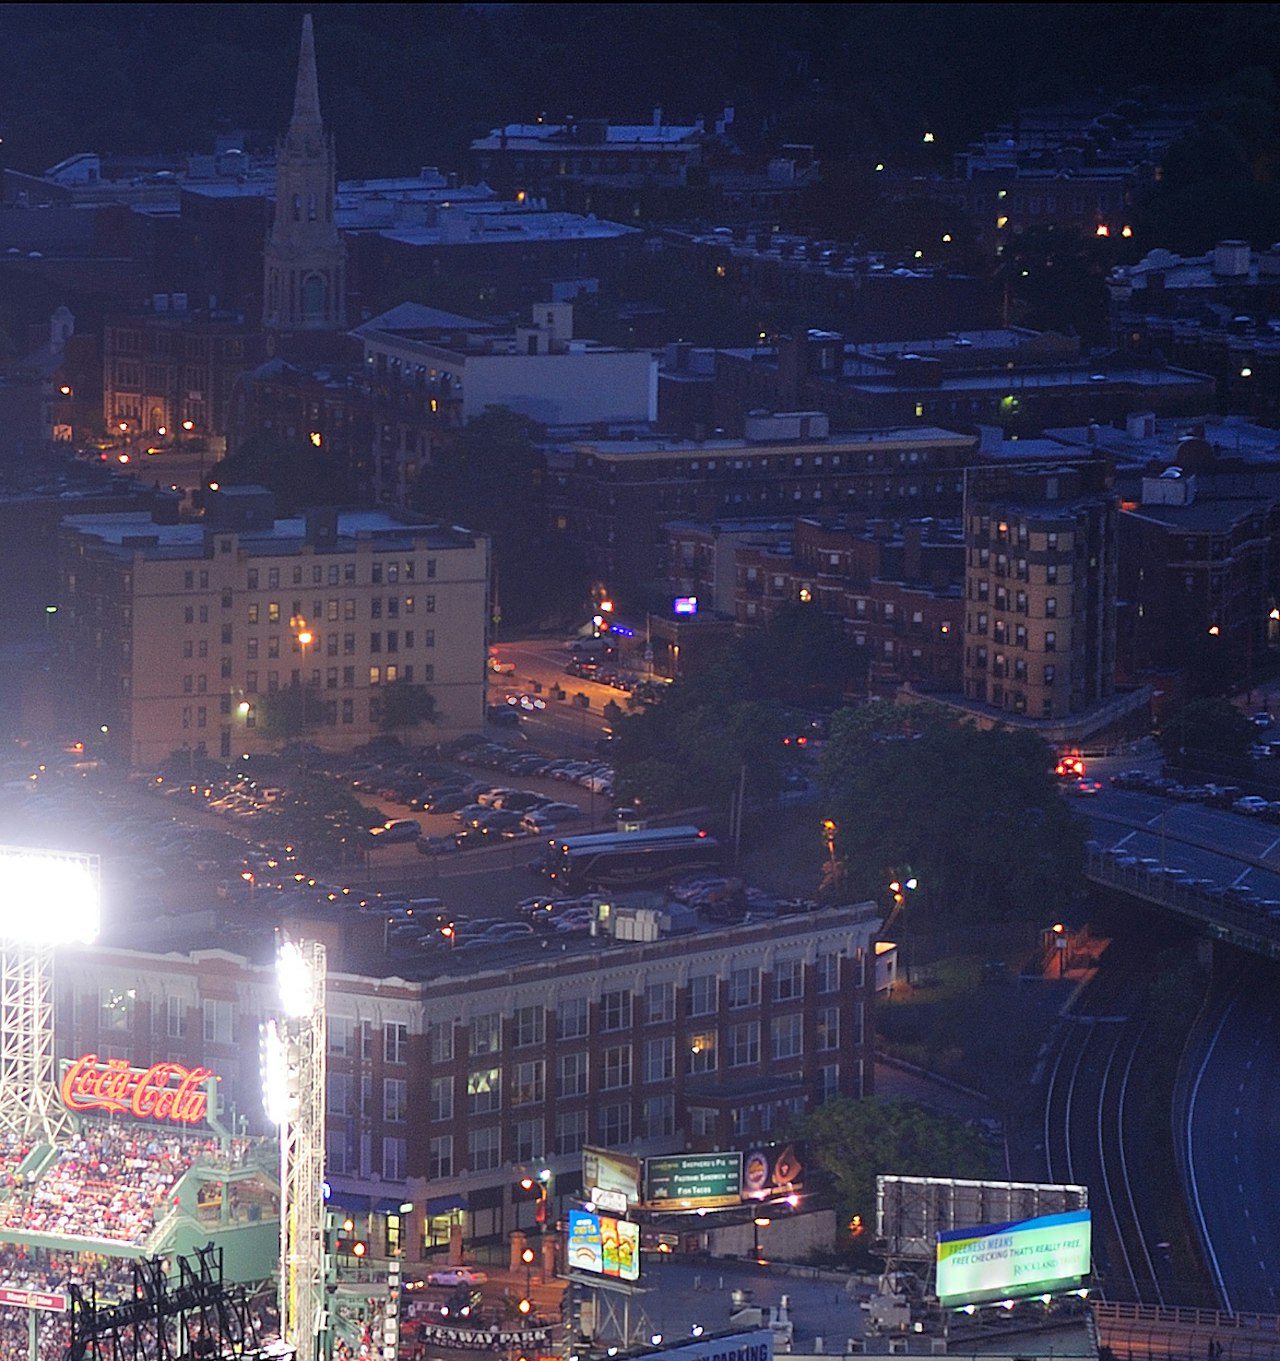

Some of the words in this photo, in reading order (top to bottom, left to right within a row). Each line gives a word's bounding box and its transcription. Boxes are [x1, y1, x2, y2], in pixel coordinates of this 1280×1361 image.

[60, 1053, 214, 1124] Coca-Cola
[716, 1158, 726, 1167] PIE
[692, 1185, 712, 1194] TACOS
[952, 1252, 969, 1266] FREE
[971, 1250, 1009, 1264] CHECKING
[1010, 1246, 1034, 1258] THAT'S
[1036, 1241, 1061, 1254] REALLY
[425, 1326, 495, 1345] FENWAY
[499, 1329, 547, 1345] PARK
